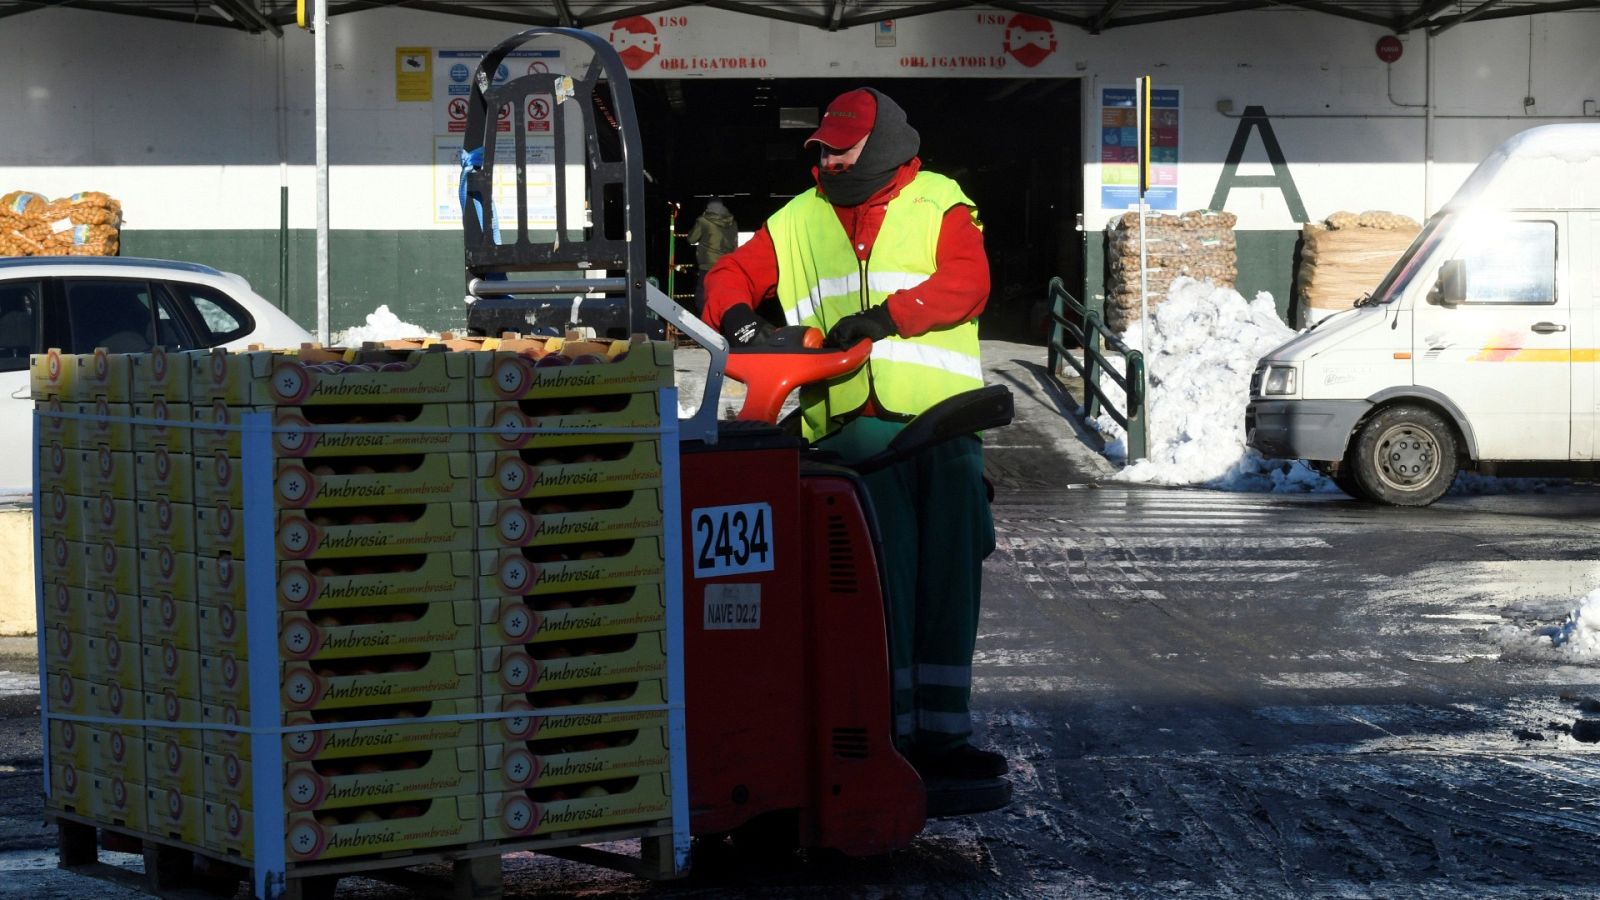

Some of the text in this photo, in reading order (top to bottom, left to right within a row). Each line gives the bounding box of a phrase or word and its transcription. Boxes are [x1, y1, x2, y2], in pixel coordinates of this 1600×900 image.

[659, 16, 688, 27] USO
[977, 14, 1006, 25] USO
[660, 57, 766, 69] OBLIGATORIO
[901, 56, 1006, 68] OBLIGATORIO
[1208, 105, 1311, 222] A
[311, 377, 382, 395] Ambrosia
[531, 370, 595, 389] Ambrosia
[533, 468, 597, 488] Ambrosia
[316, 479, 386, 498] Ambrosia
[535, 517, 599, 537] Ambrosia
[318, 530, 387, 549] Ambrosia
[697, 509, 768, 569] 2434
[536, 565, 600, 585] Ambrosia
[318, 580, 388, 599] Ambrosia
[537, 613, 601, 633] Ambrosia
[708, 604, 757, 624] NAVE D2.2
[320, 630, 390, 650] Ambrosia
[537, 662, 601, 682] Ambrosia
[323, 680, 392, 700] Ambrosia
[324, 728, 393, 749] Ambrosia
[539, 757, 602, 778] Ambrosia
[325, 780, 394, 800] Ambrosia
[539, 804, 603, 826] Ambrosia
[326, 828, 394, 849] Ambrosia
